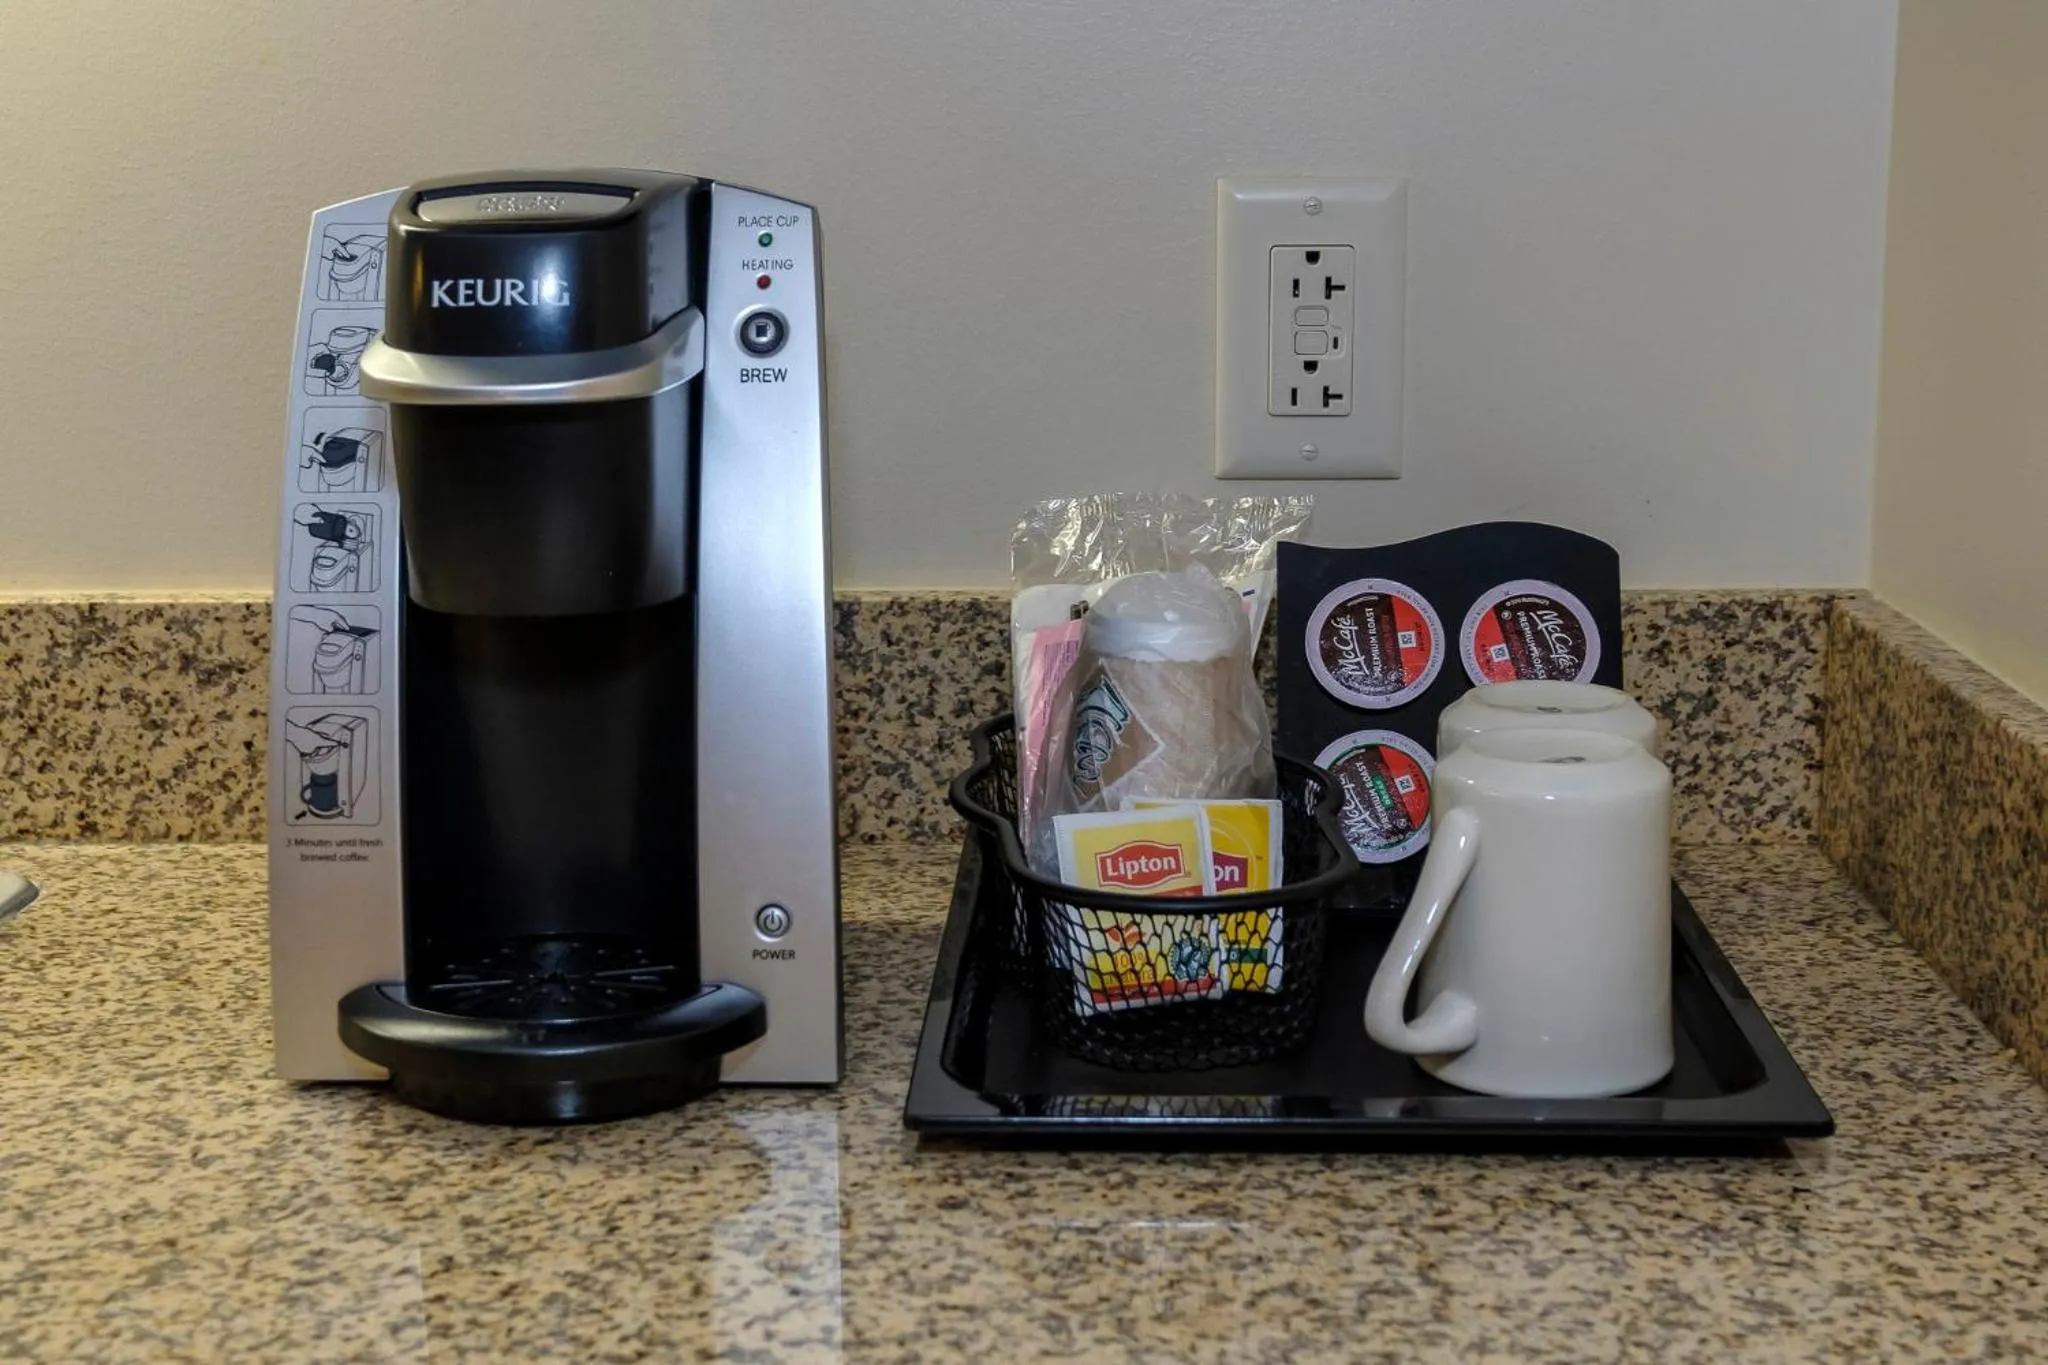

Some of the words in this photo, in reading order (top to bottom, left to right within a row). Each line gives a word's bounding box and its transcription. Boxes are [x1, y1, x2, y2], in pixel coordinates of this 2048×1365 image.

[738, 216, 773, 227] PLACE
[776, 215, 799, 227] CUP
[742, 259, 794, 271] HEATING
[431, 278, 570, 308] KEURIG
[740, 368, 787, 383] BREW
[1365, 607, 1376, 634] ROAST
[1517, 610, 1537, 653] PREMIUM
[1356, 760, 1374, 788] ROAST
[1105, 855, 1177, 880] Lipton
[752, 949, 796, 960] POWER
